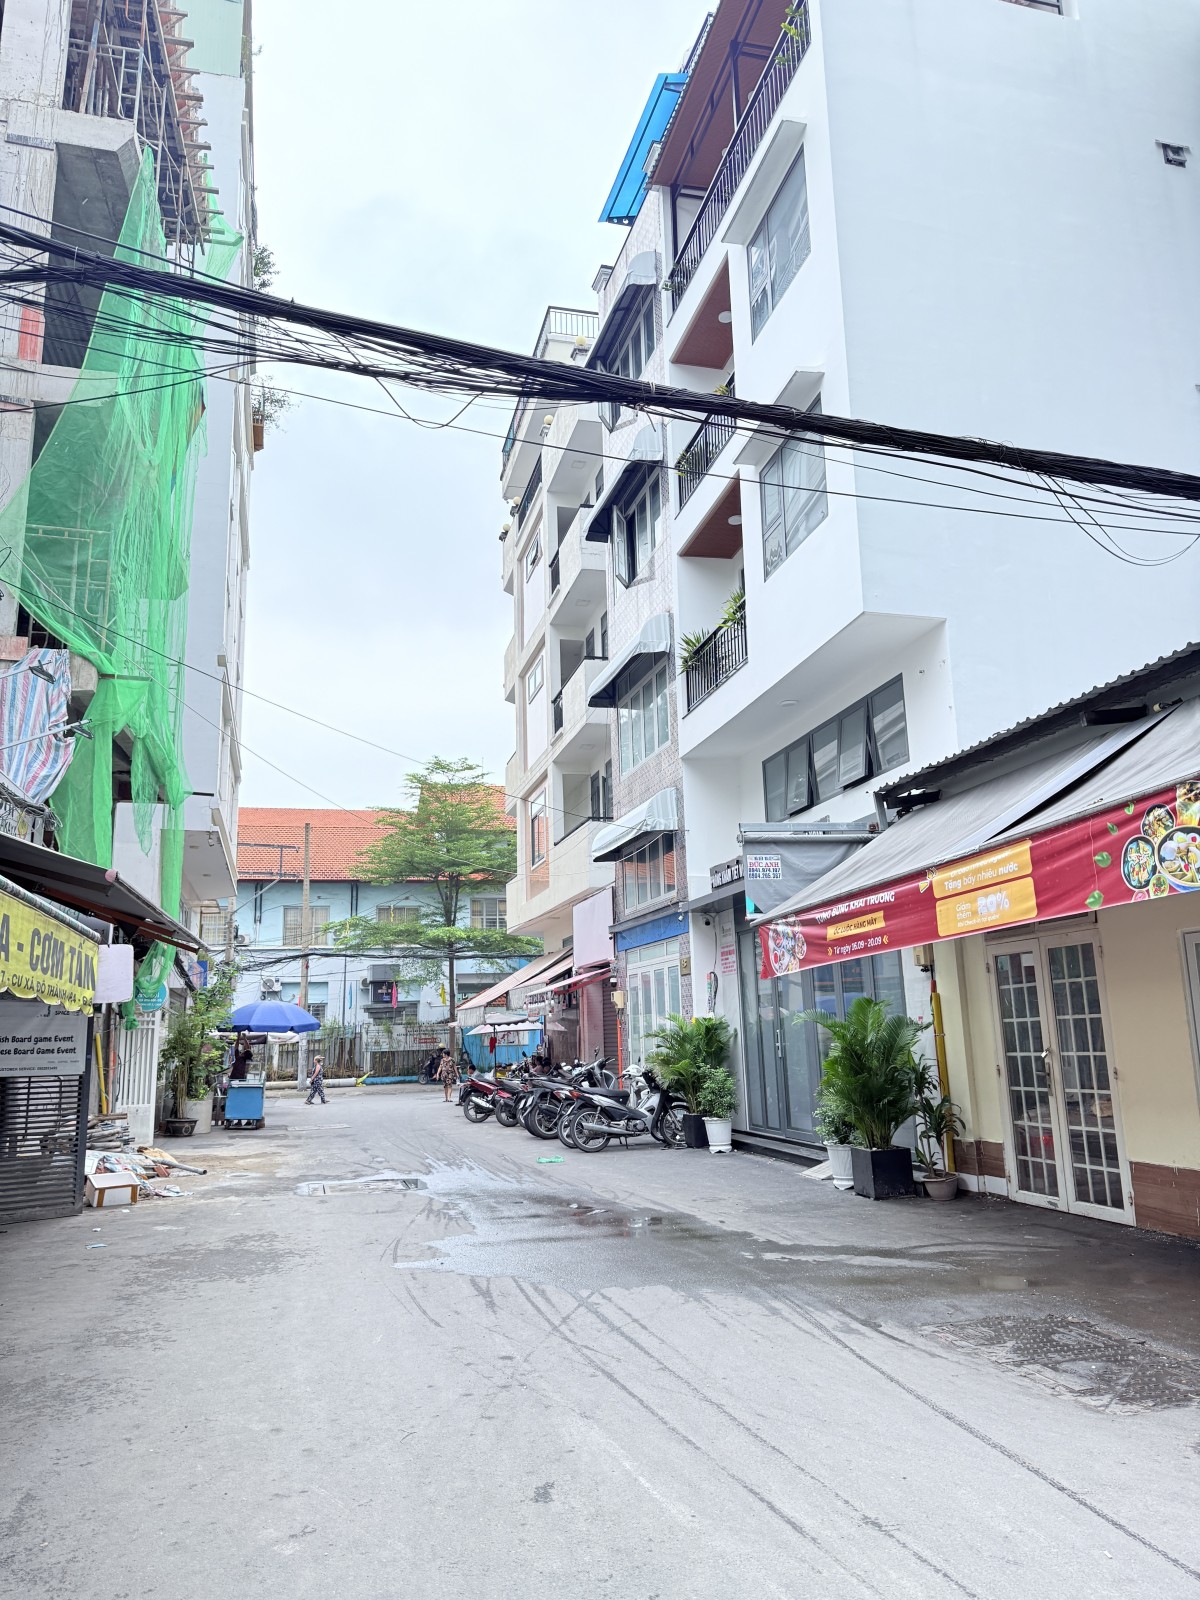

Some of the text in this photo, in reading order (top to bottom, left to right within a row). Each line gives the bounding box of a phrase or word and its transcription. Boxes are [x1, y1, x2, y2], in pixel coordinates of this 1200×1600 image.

[977, 868, 997, 881] nhiêu
[998, 862, 1019, 876] nước
[849, 899, 865, 910] KHAI
[977, 891, 1010, 915] 20%
[840, 944, 851, 955] ngày
[851, 941, 865, 951] 16.09
[867, 936, 882, 947] 20.09
[29, 927, 65, 981] CƠM
[68, 940, 96, 992] TẤM
[11, 1035, 32, 1043] Board
[33, 1036, 52, 1045] game
[54, 1035, 74, 1043] Event
[14, 1047, 35, 1055] Board
[36, 1046, 55, 1055] Game
[57, 1046, 76, 1054] Event
